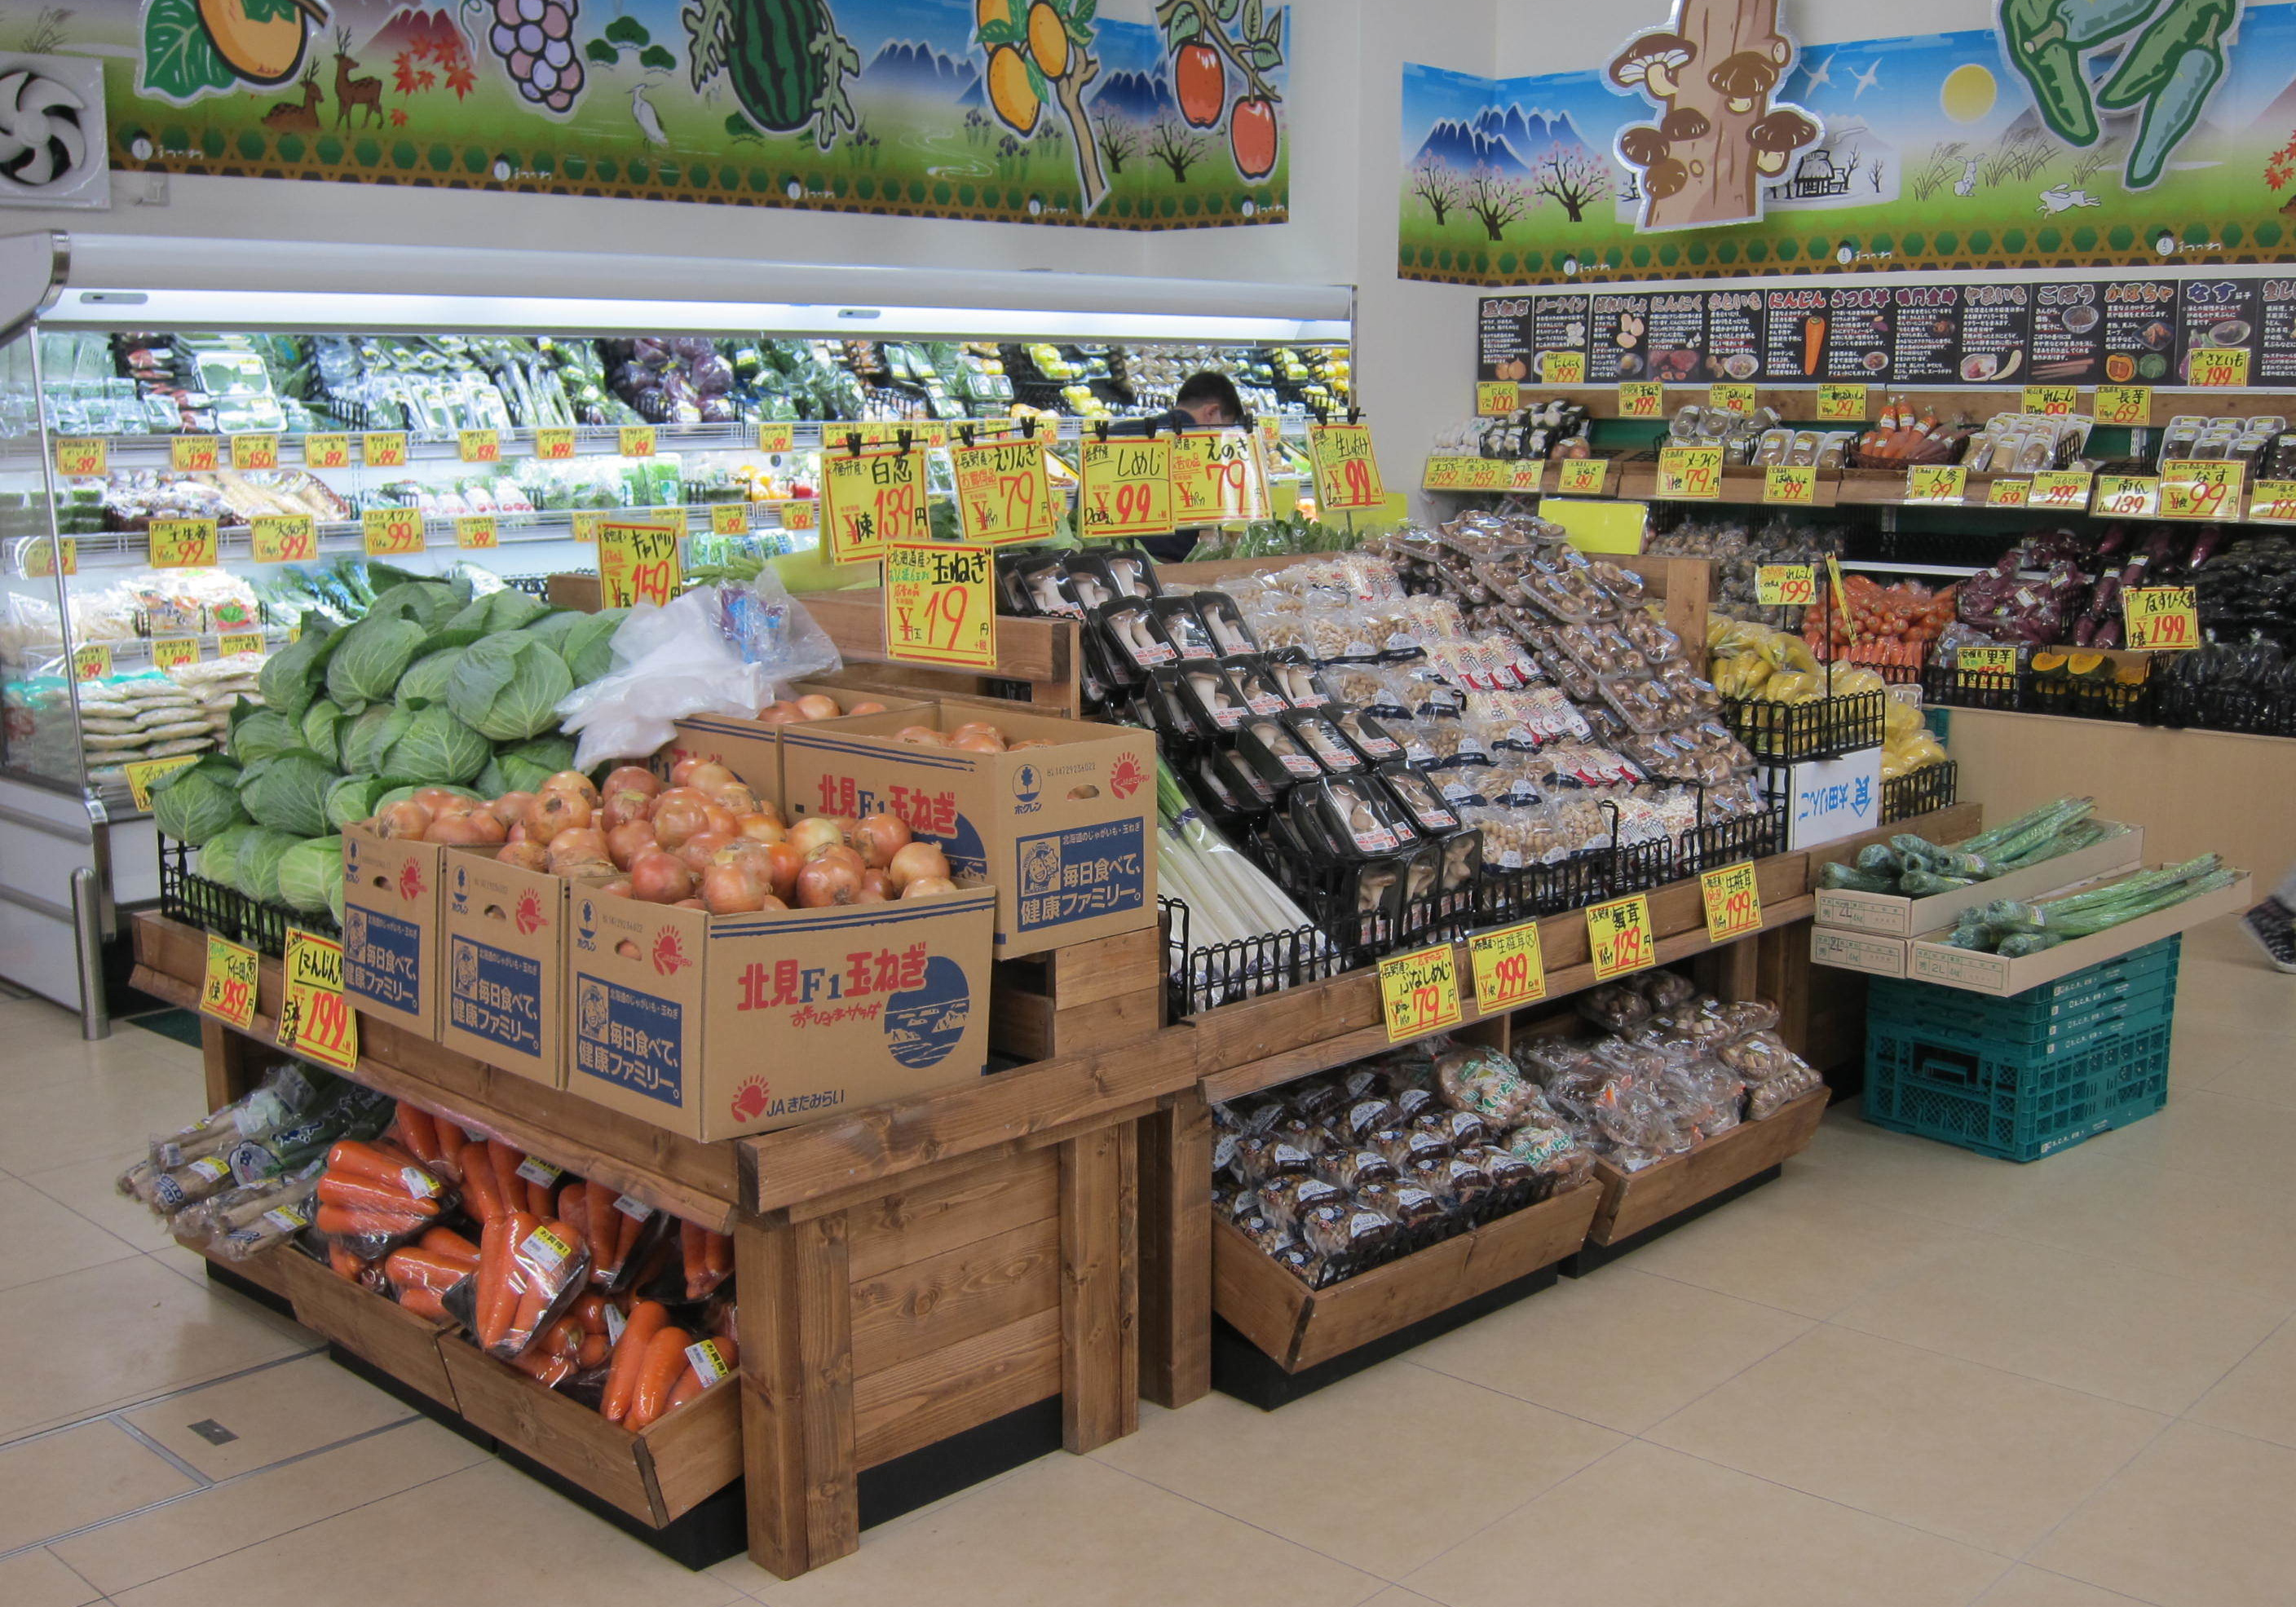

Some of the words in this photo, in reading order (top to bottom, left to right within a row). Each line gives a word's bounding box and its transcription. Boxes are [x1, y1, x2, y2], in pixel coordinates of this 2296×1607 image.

[1536, 296, 1587, 314] メークイン
[1650, 294, 1702, 312] にんにく
[1708, 292, 1762, 311] さといも
[1768, 290, 1826, 309] にんじん
[1831, 288, 1890, 308] さつま芋
[1896, 287, 1957, 307] 鳴門金時
[1964, 285, 2027, 306] やまいも
[2104, 283, 2174, 303] かぼちゃ
[2206, 352, 2243, 368] さといも
[2203, 367, 2232, 386] 199
[1633, 396, 1656, 415] 199
[1835, 400, 1854, 417] 29
[2116, 389, 2145, 404] 長芋
[2113, 403, 2139, 423] 69
[1205, 436, 1248, 461] えのき
[188, 453, 212, 470] 129
[1118, 448, 1164, 477] しめじ
[1206, 460, 1246, 514] 79
[1345, 458, 1371, 506] 99
[1685, 469, 1710, 492] 79
[1931, 470, 1960, 485] 人参
[2193, 468, 2228, 484] なす
[999, 471, 1034, 535] 79
[1115, 483, 1150, 523] 99
[1783, 483, 1802, 499] 99
[1930, 483, 1952, 501] 99
[2046, 485, 2078, 505] 299
[2189, 481, 2227, 514] 99
[874, 484, 914, 541] 139
[2111, 496, 2145, 514] 139
[280, 534, 307, 561] 99
[387, 523, 412, 550] 99
[178, 540, 205, 564] 99
[931, 547, 991, 585] 玉ねぎ
[1779, 580, 1811, 603] 199
[924, 585, 969, 650] 19
[2151, 615, 2186, 643] 199
[1987, 650, 2011, 664] 里芋
[1013, 802, 1042, 815] ホクレン
[1062, 853, 1141, 888] 毎日食べて、
[1725, 868, 1751, 894] 生椎茸
[1020, 884, 1141, 925] 健康ファミリー。
[1725, 890, 1751, 929] 199
[1614, 927, 1640, 970] 129
[366, 943, 417, 981] 毎日食べて、
[1932, 963, 1945, 974] 2L
[344, 962, 418, 1009] 健康ファミリー。
[737, 941, 927, 1011] 北見F1玉ねぎ
[1495, 953, 1528, 999] 299
[479, 978, 538, 1020] 毎日食べて、
[1413, 985, 1440, 1027] 79
[303, 991, 348, 1049] 199
[453, 997, 540, 1050] 健康ファミリー。
[610, 1020, 678, 1068] 毎日食べて、
[579, 1040, 680, 1100] 健康ファミリー。
[766, 1089, 845, 1117] JAきたみらい
